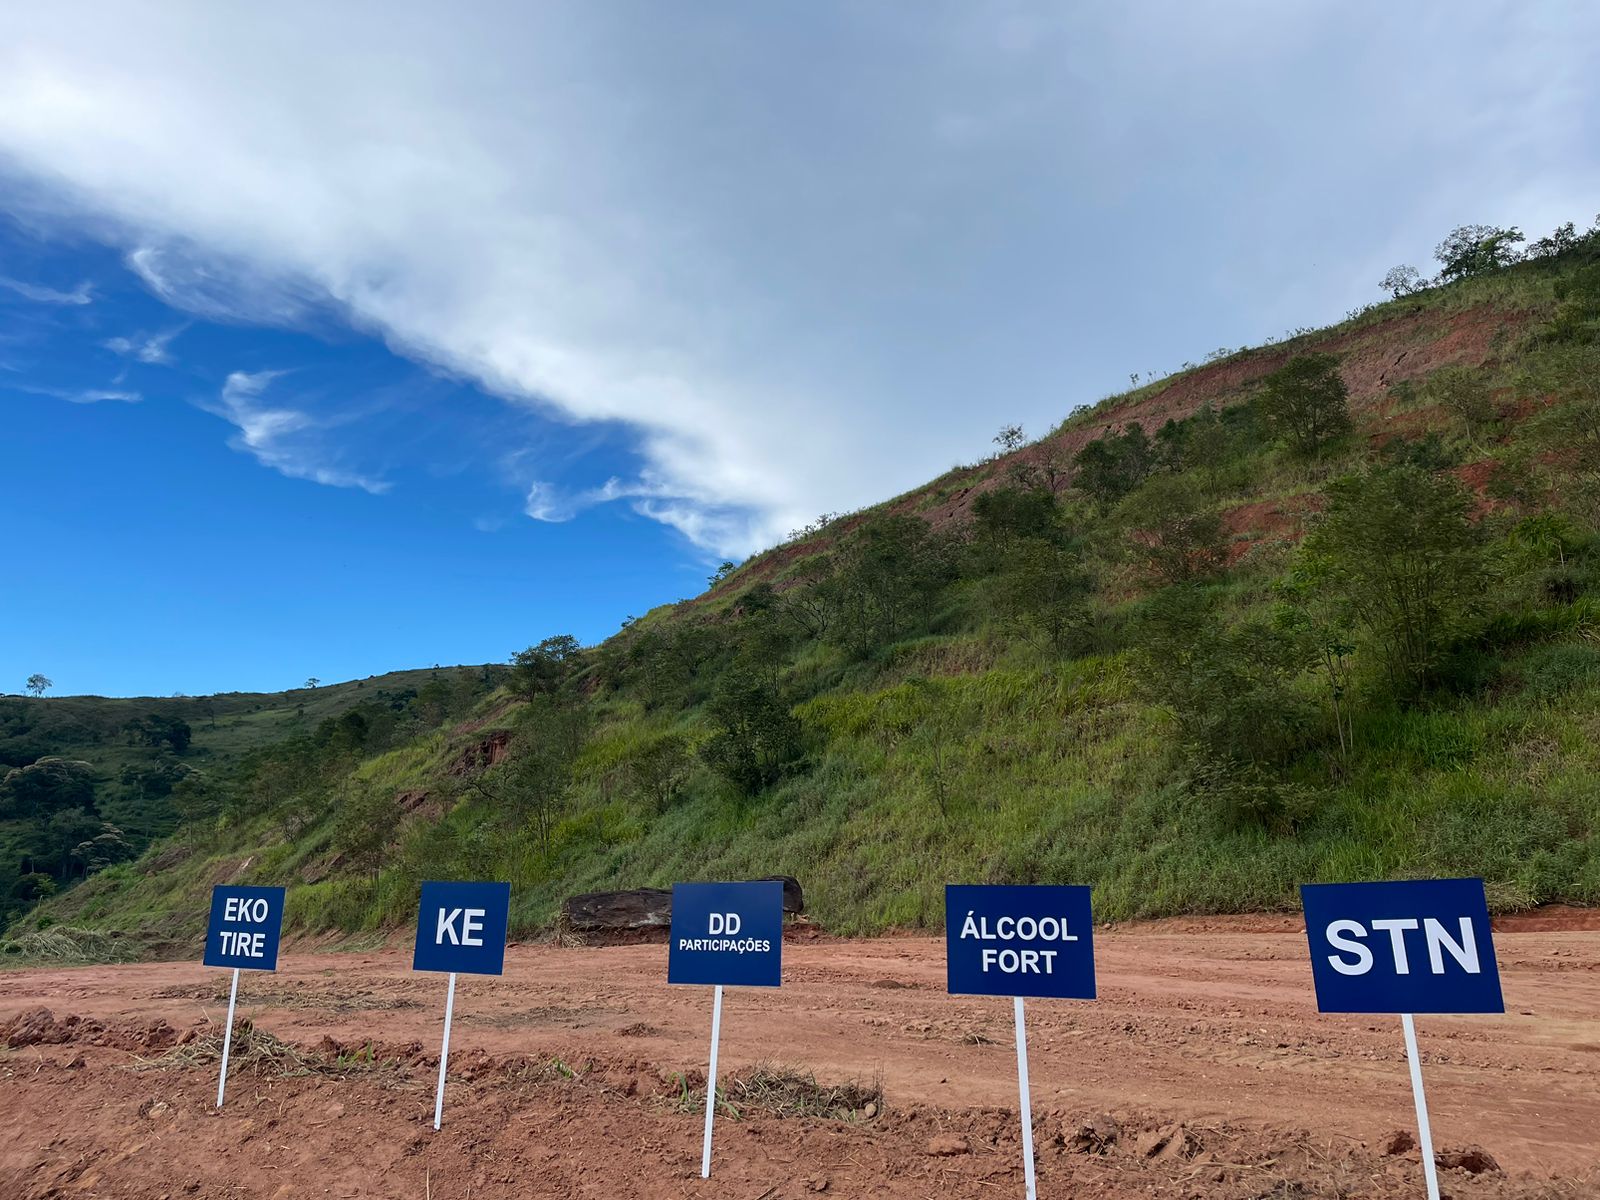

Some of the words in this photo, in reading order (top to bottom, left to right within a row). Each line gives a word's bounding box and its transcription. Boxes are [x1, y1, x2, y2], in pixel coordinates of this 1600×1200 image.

[224, 897, 269, 923] EKO
[435, 908, 486, 947] KE
[708, 913, 741, 935] DD
[960, 910, 1078, 941] ÁLCOOL
[219, 931, 266, 958] TIRE
[679, 937, 771, 955] PARTICIPAÇÕES
[1325, 916, 1481, 976] STN
[982, 949, 1058, 974] FORT
